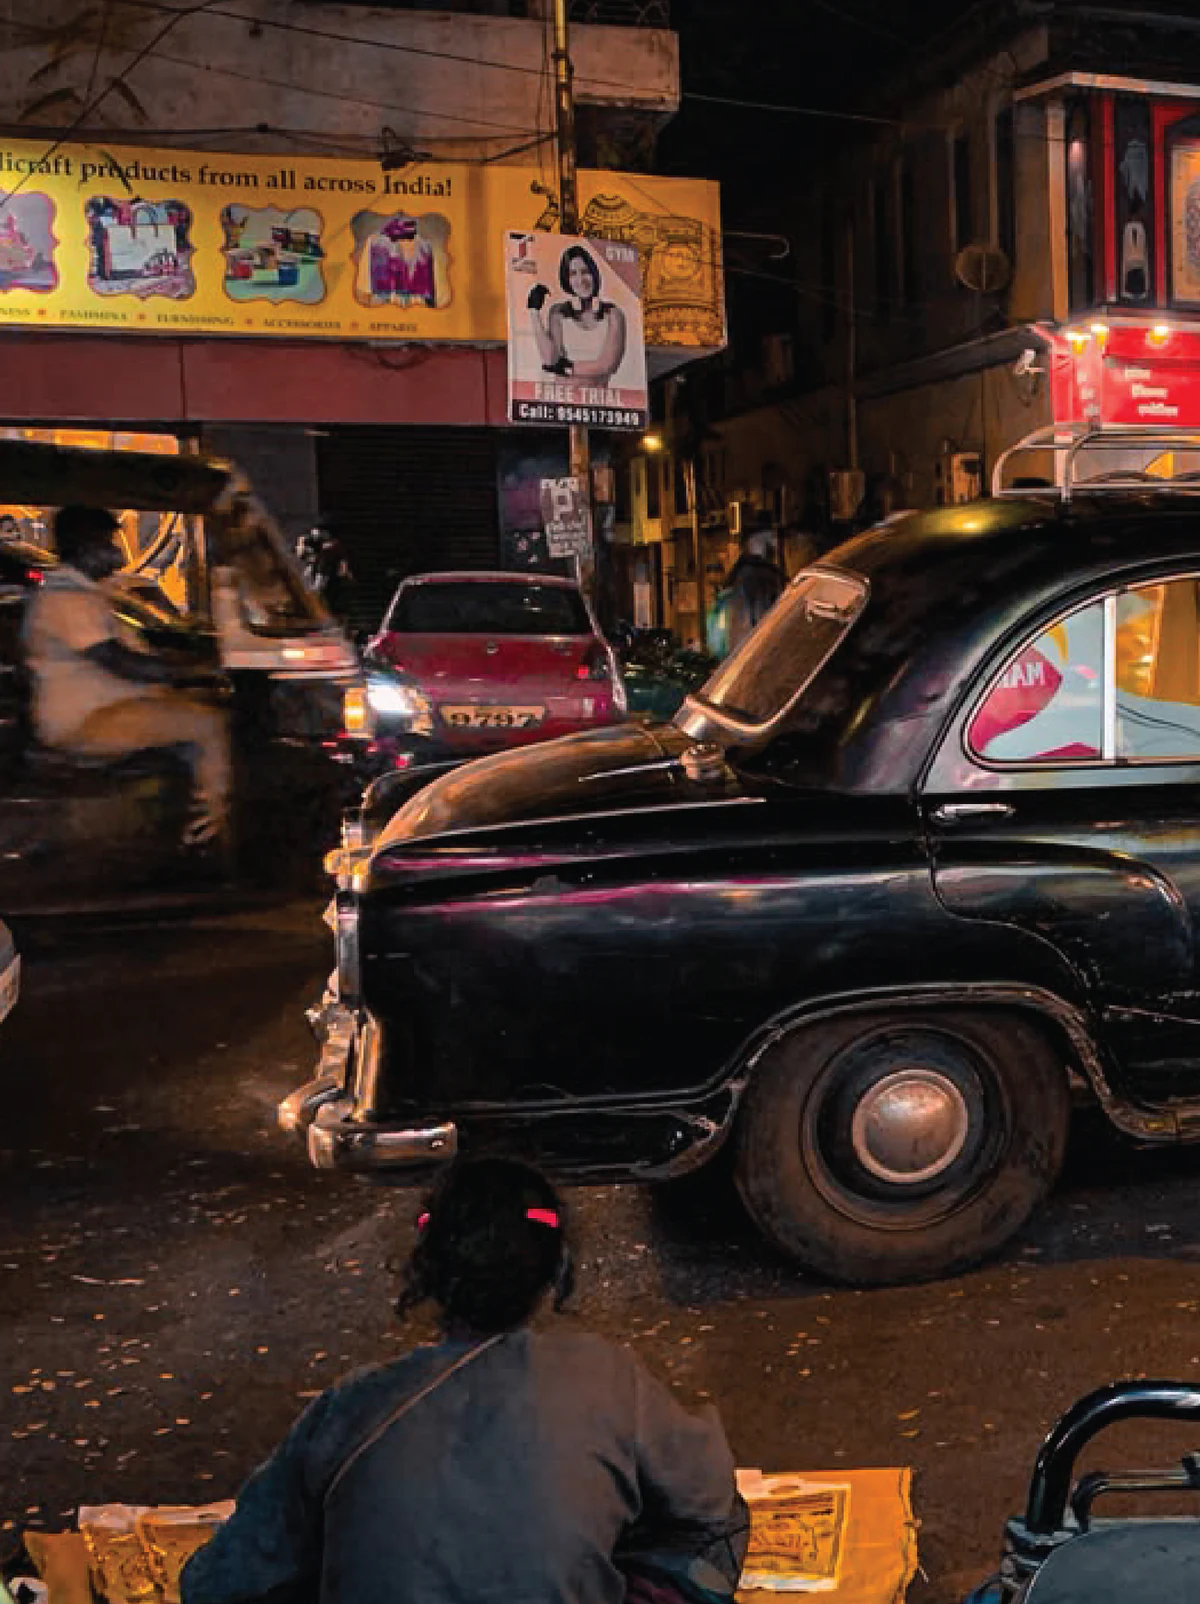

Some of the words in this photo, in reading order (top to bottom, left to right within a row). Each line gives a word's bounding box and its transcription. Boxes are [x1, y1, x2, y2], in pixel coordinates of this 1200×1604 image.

[80, 160, 192, 183] products
[199, 163, 258, 187] from
[266, 169, 296, 190] all
[304, 175, 376, 193] across
[383, 174, 452, 197] India!
[535, 382, 575, 402] FREE
[579, 387, 624, 407] TRIAL
[519, 403, 554, 419] Call:
